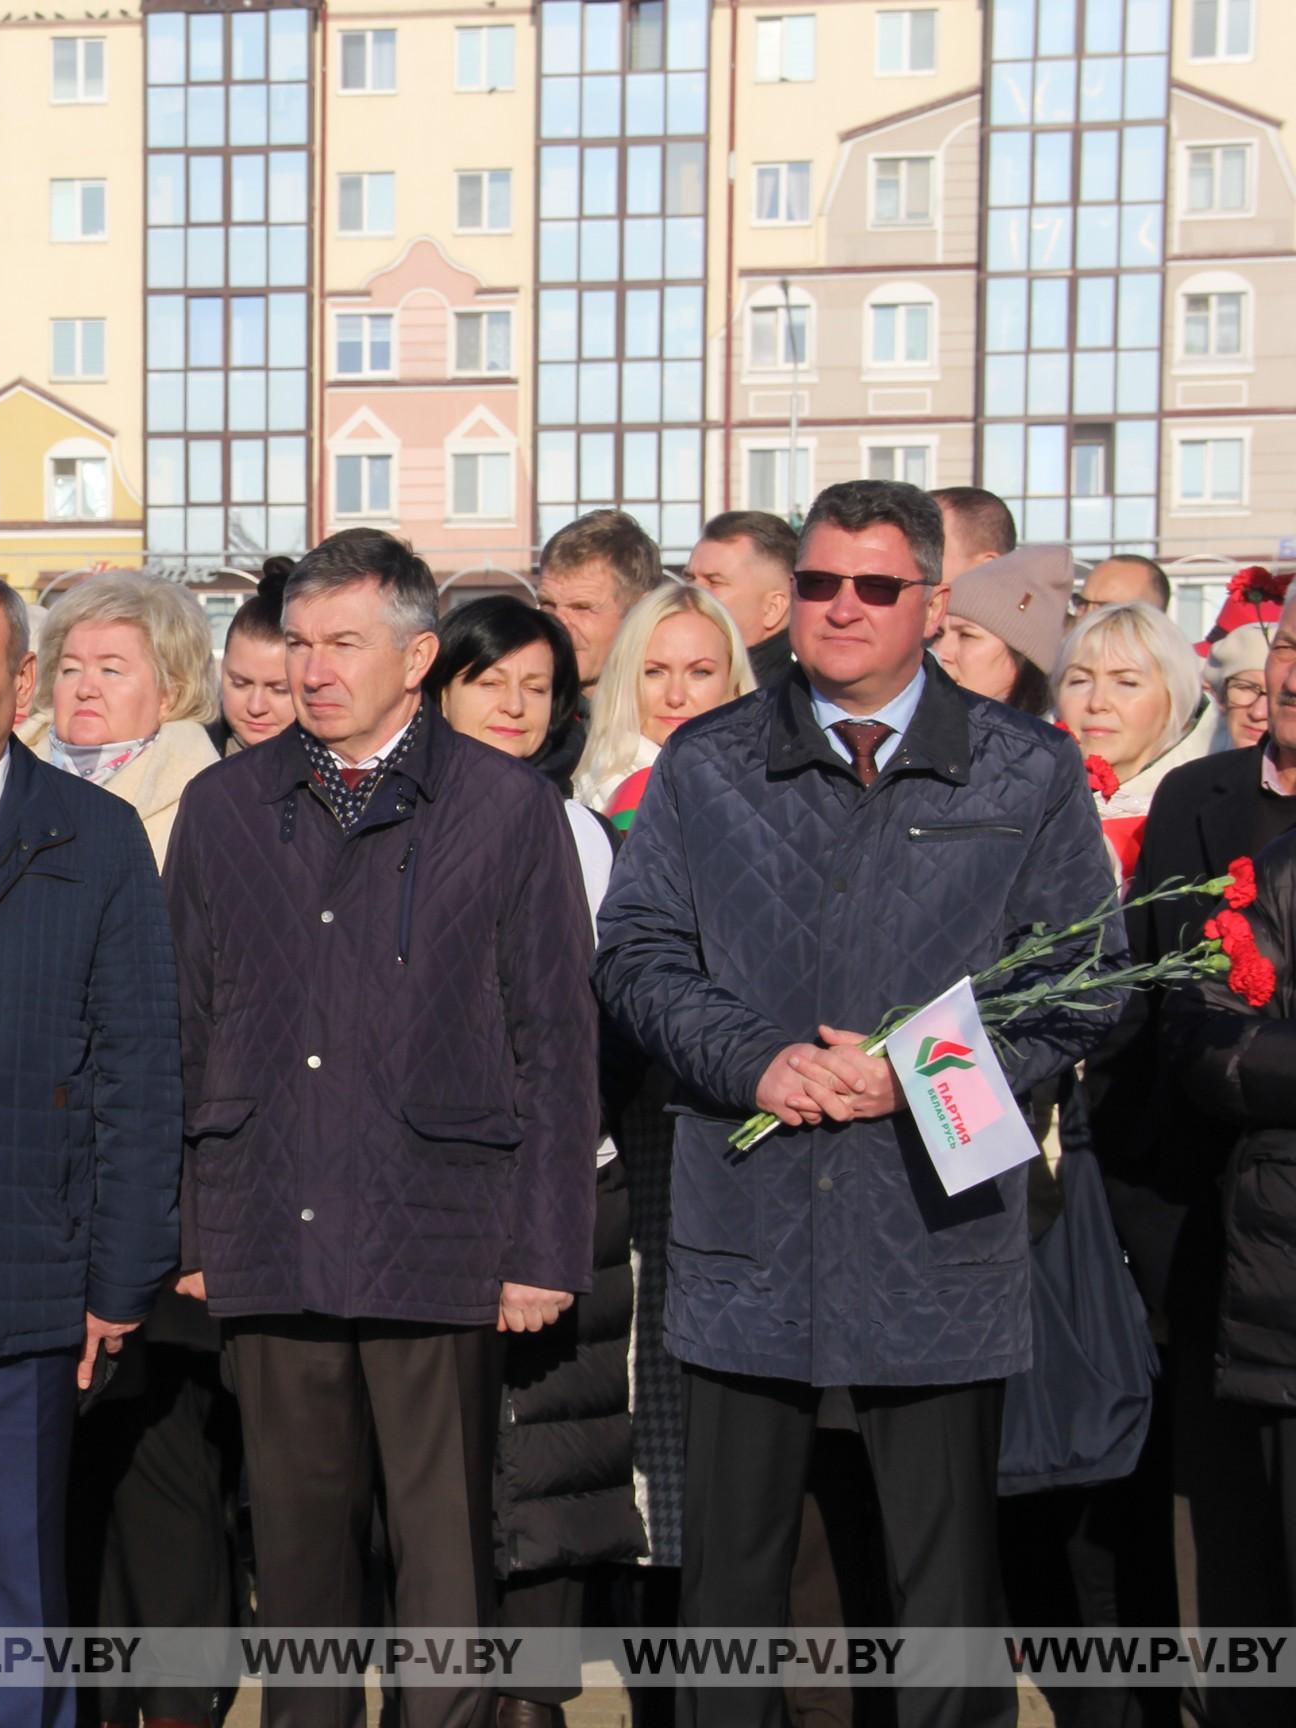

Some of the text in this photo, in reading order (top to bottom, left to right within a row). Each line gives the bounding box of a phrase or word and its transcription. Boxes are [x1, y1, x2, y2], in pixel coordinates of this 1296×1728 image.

[927, 1087, 956, 1149] БЕЛАЯ РУСЬ
[937, 1082, 971, 1145] ПАРТИЯ
